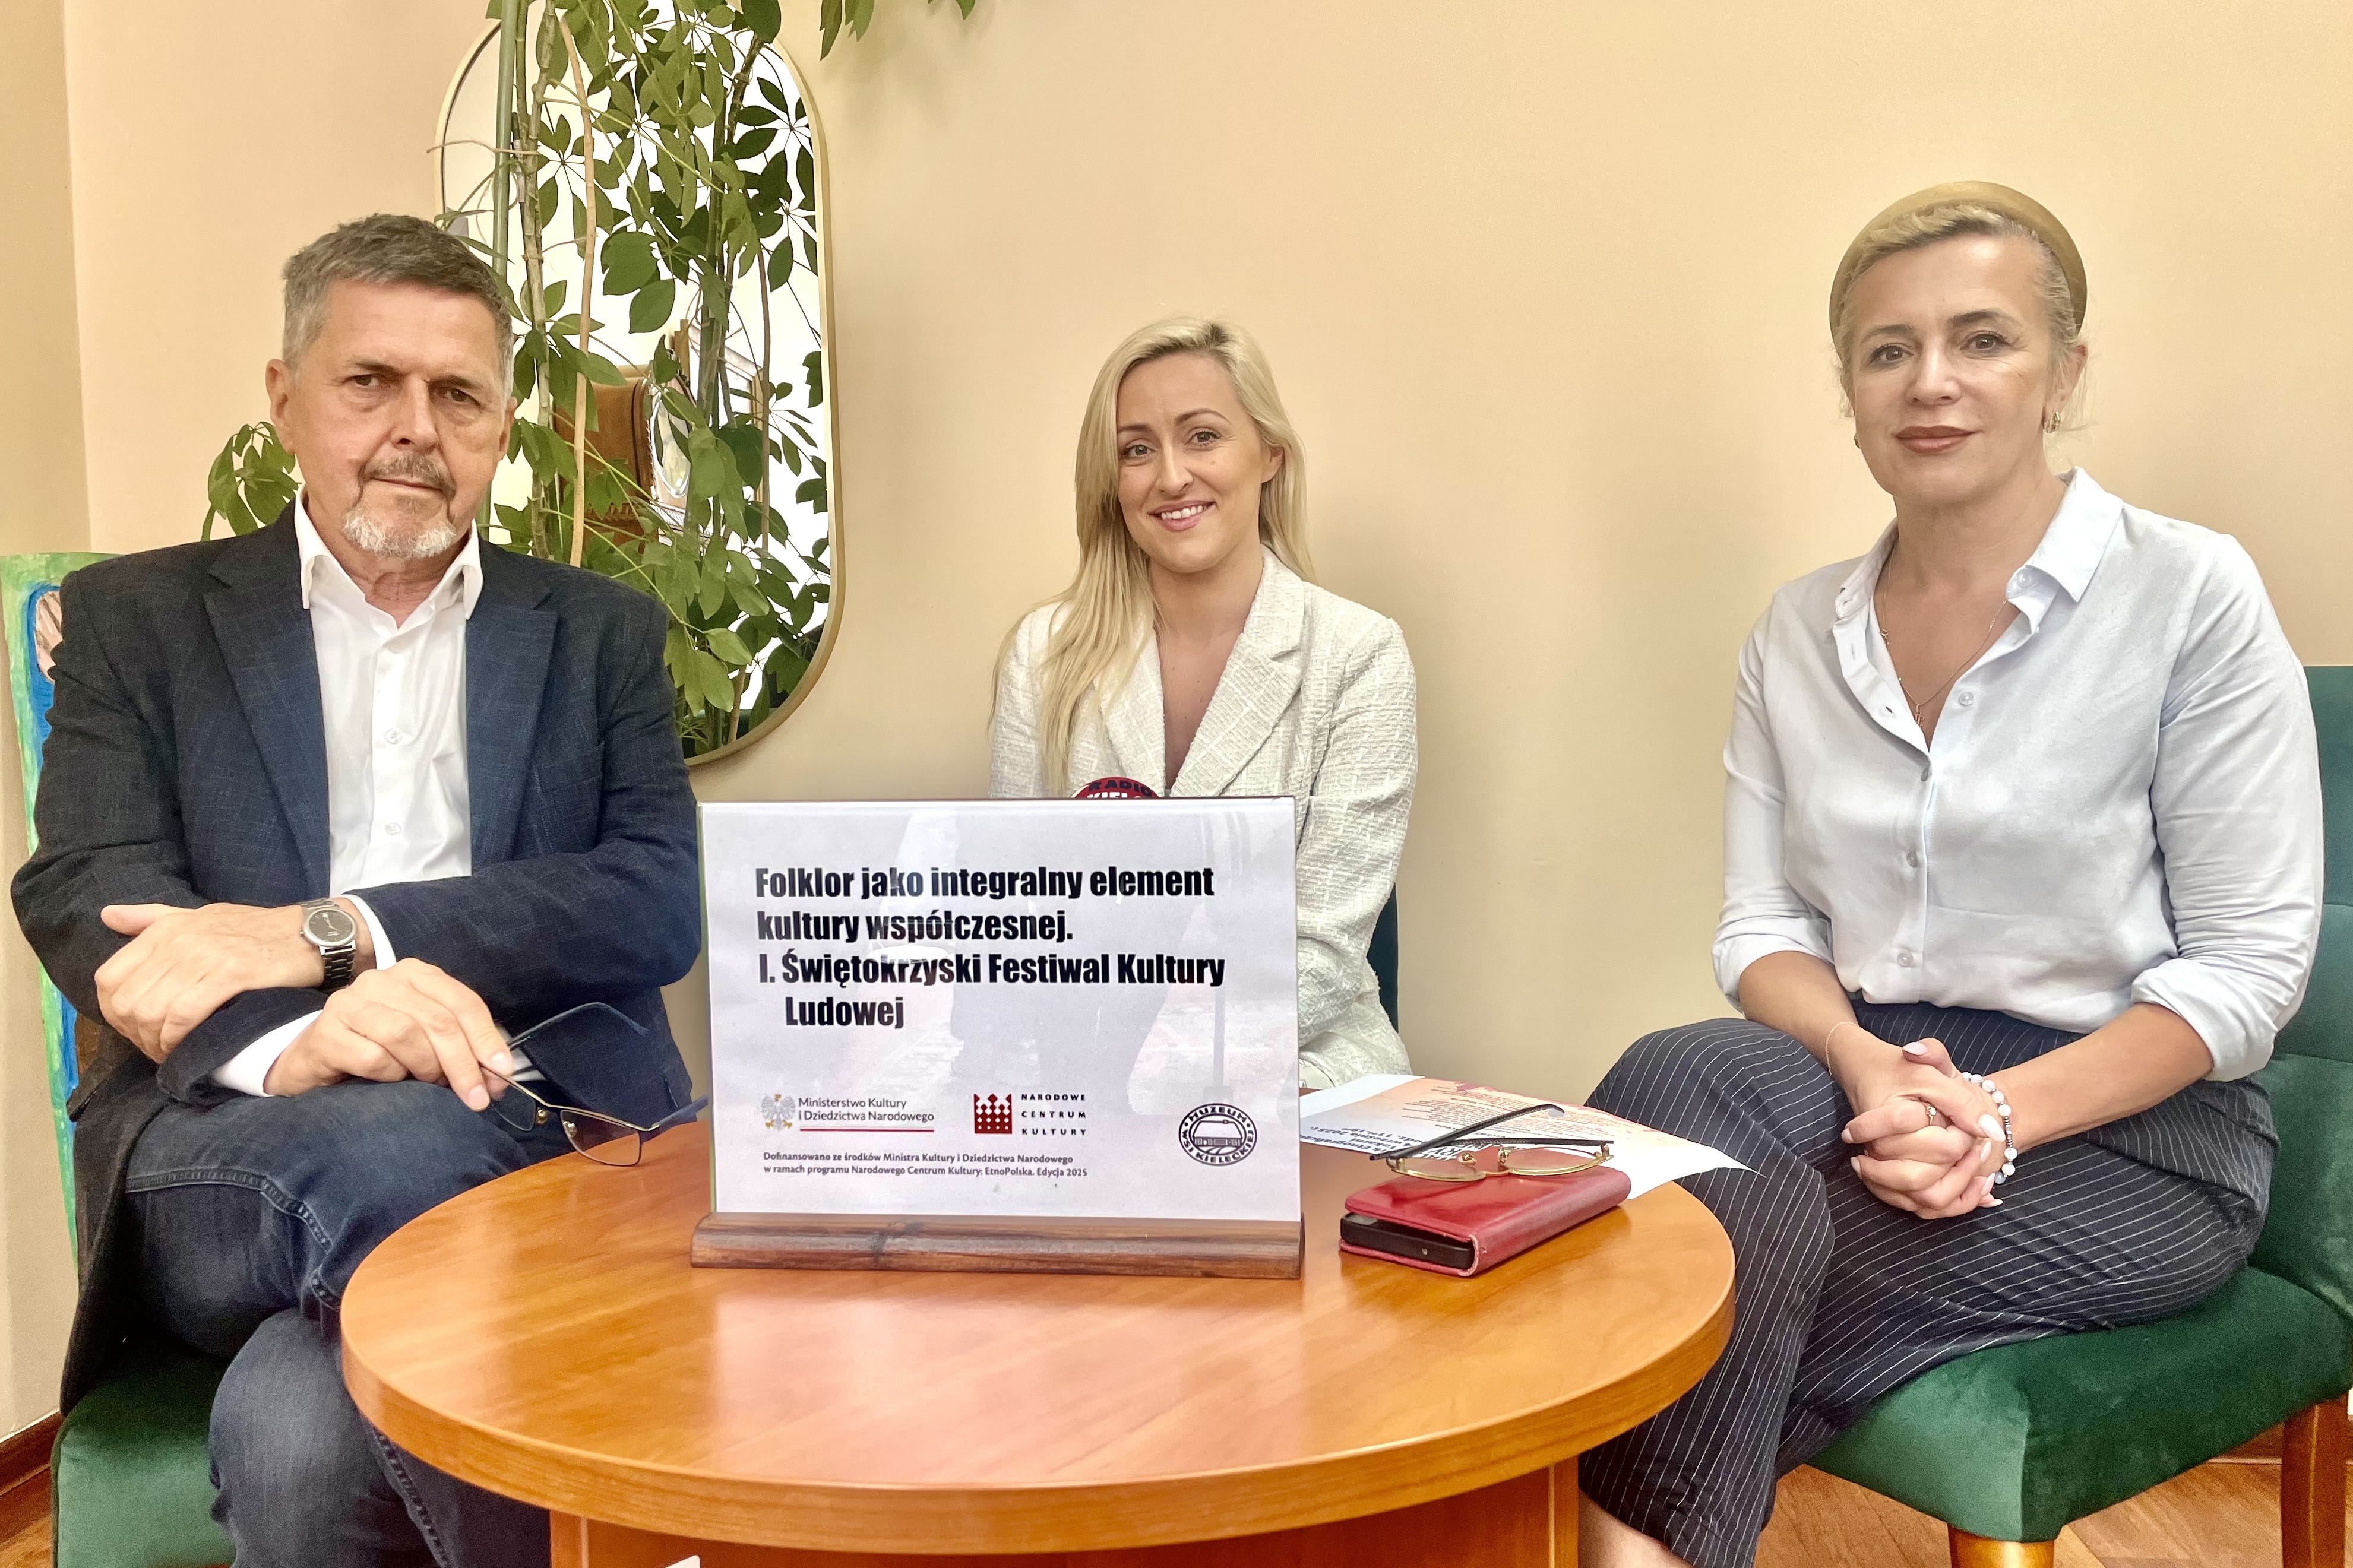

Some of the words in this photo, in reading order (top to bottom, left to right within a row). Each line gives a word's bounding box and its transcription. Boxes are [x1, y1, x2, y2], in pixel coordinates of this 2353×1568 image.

[1089, 780, 1152, 797] RADIO
[756, 867, 855, 897] Folklor
[861, 867, 924, 899] jako
[931, 867, 1083, 899] integralny
[1090, 866, 1215, 896] element
[757, 911, 859, 943] kultury
[866, 910, 1073, 943] współczesnej.
[760, 954, 776, 983] I.
[782, 948, 981, 988] Świętokrzyski
[989, 954, 1109, 983] Festiwal
[1118, 954, 1225, 987] Kultury
[785, 997, 904, 1029] Ludowej
[798, 1098, 865, 1108] Ministerstwo
[868, 1098, 907, 1109] Kultury
[799, 1111, 801, 1120] i
[804, 1111, 865, 1120] Dziedzictwa
[868, 1111, 934, 1123] Narodowego
[1188, 1107, 1247, 1123] MUZEUM
[1182, 1129, 1194, 1152] WSI
[1196, 1130, 1254, 1163] KIELECKIEJ
[763, 1152, 831, 1161] Dofinansowano
[845, 1152, 881, 1161] środków
[883, 1153, 919, 1161] Ministra
[922, 1154, 955, 1164] Kultury
[957, 1154, 960, 1162] i
[962, 1154, 1015, 1162] Dziedzictwa
[1017, 1154, 1073, 1165] Narodowego
[773, 1165, 805, 1173] ramach
[807, 1167, 849, 1175] programu
[852, 1165, 906, 1176] Narodowego
[985, 1167, 1035, 1176] EtnoPolska.
[1037, 1167, 1064, 1179] Edycja
[1067, 1168, 1087, 1177] 2025
